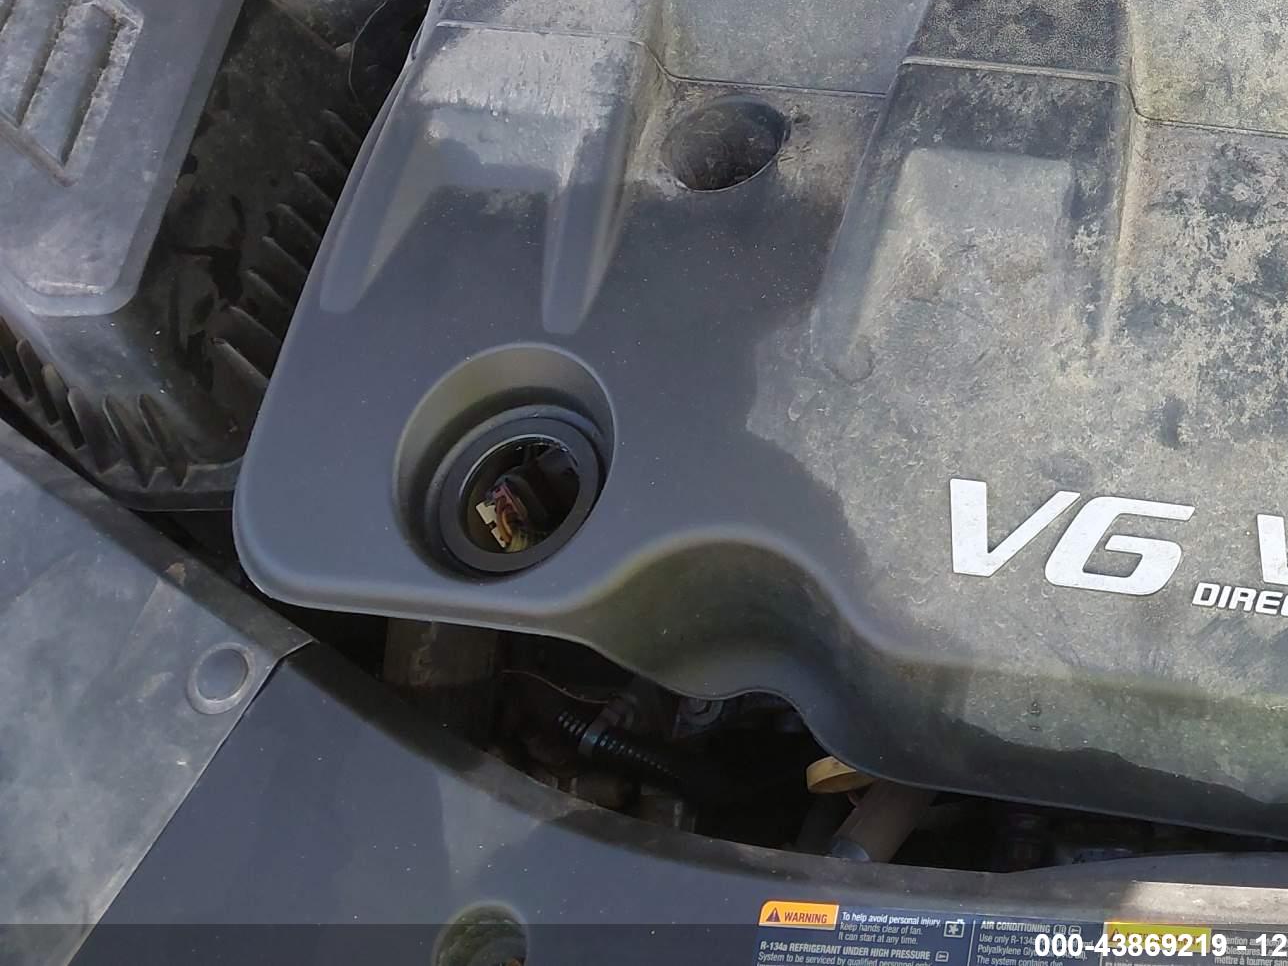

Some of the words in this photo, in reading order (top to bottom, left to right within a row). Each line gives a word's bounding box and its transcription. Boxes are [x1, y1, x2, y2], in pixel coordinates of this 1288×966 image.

[950, 478, 1196, 595] V6
[784, 911, 828, 924] WARNING
[842, 912, 850, 921] To
[852, 913, 867, 923] help
[868, 914, 888, 923] avoid
[889, 916, 919, 926] personal
[860, 923, 881, 933] hands
[882, 925, 900, 934] clear
[901, 925, 908, 934] of
[980, 921, 994, 930] AIR
[996, 922, 1050, 934] CONDITIONING
[844, 933, 858, 942] can
[859, 933, 875, 942] start
[876, 934, 884, 943] at
[885, 935, 899, 945] any
[979, 934, 993, 943] Use
[994, 934, 1010, 945] only
[788, 943, 842, 955] REFRIGERANT
[842, 946, 869, 956] UNDER
[870, 948, 890, 959] HIGH
[890, 948, 931, 960] PRESSURE
[977, 944, 1021, 956] Polyalkylene
[758, 951, 785, 963] System
[786, 953, 793, 962] to
[795, 953, 804, 963] be
[805, 954, 836, 965] serviced
[837, 956, 846, 966] by
[848, 957, 878, 966] qualified
[976, 955, 987, 965] The
[991, 956, 1016, 966] system
